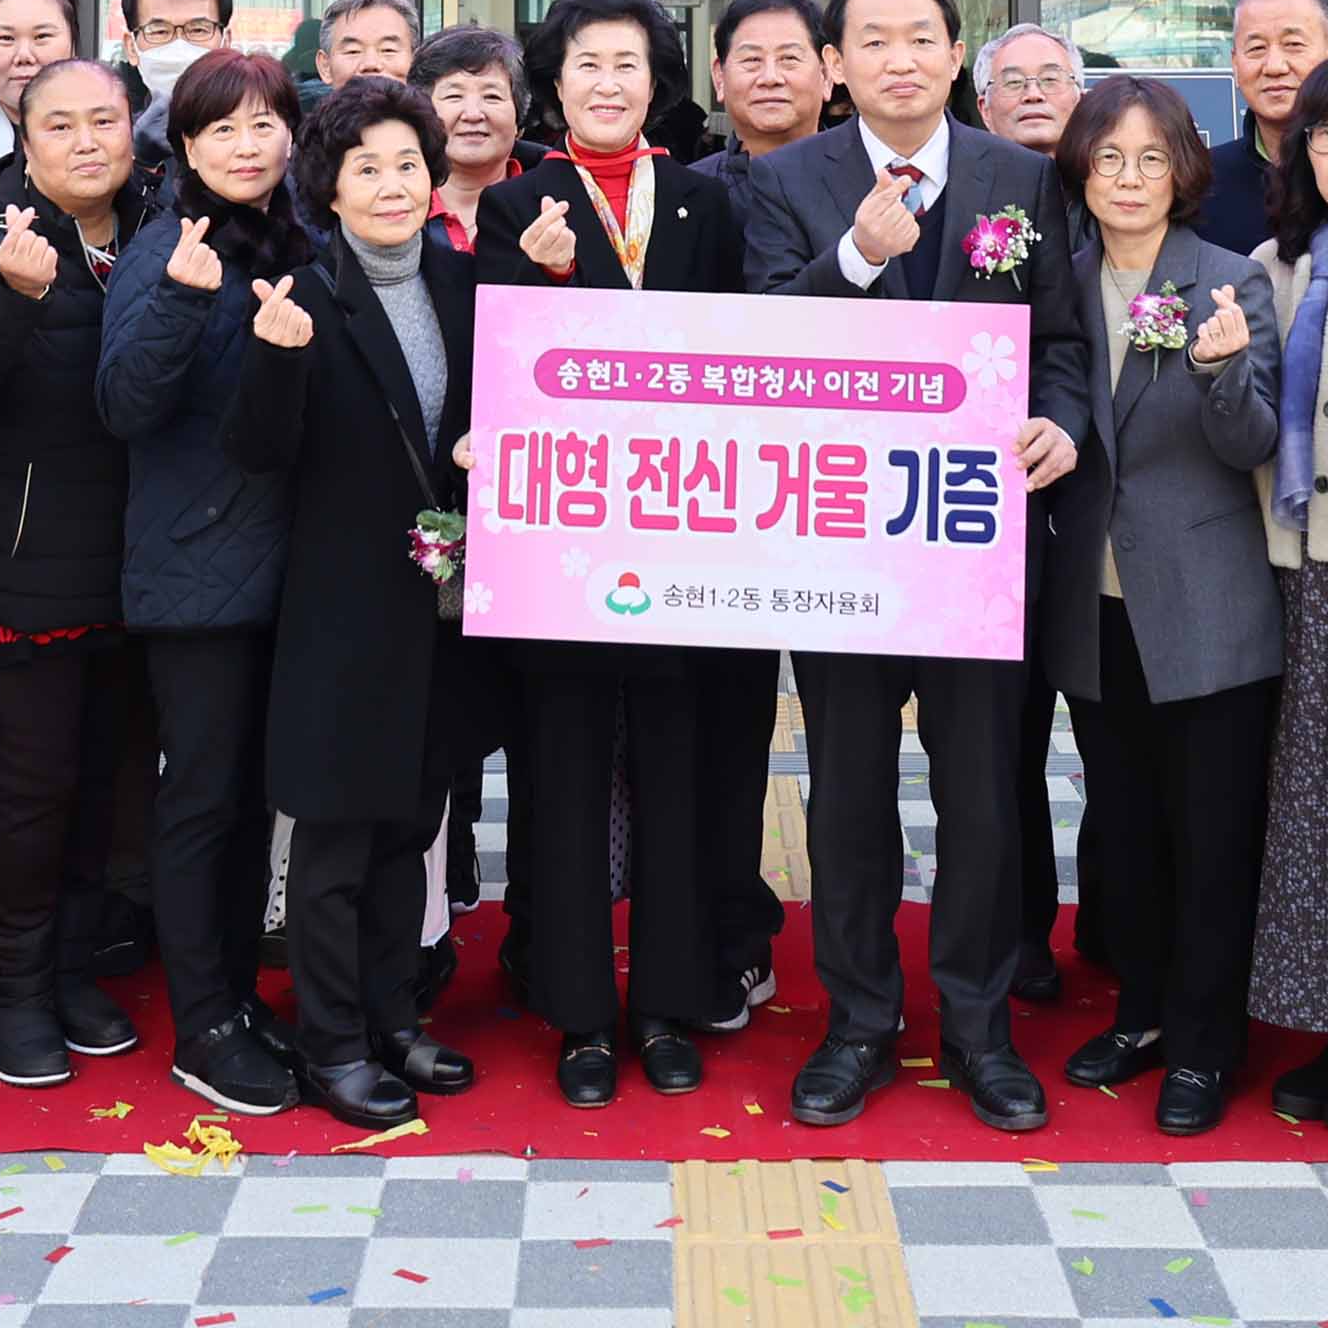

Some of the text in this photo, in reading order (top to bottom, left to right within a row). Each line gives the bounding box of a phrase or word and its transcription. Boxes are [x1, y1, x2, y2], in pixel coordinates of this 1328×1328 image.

[556, 357, 946, 406] 송현1·2동 복합청사 이전 기념
[497, 430, 1000, 545] 대형 전신 거울 기증
[662, 583, 882, 618] 송현1·2동 통장자율회
